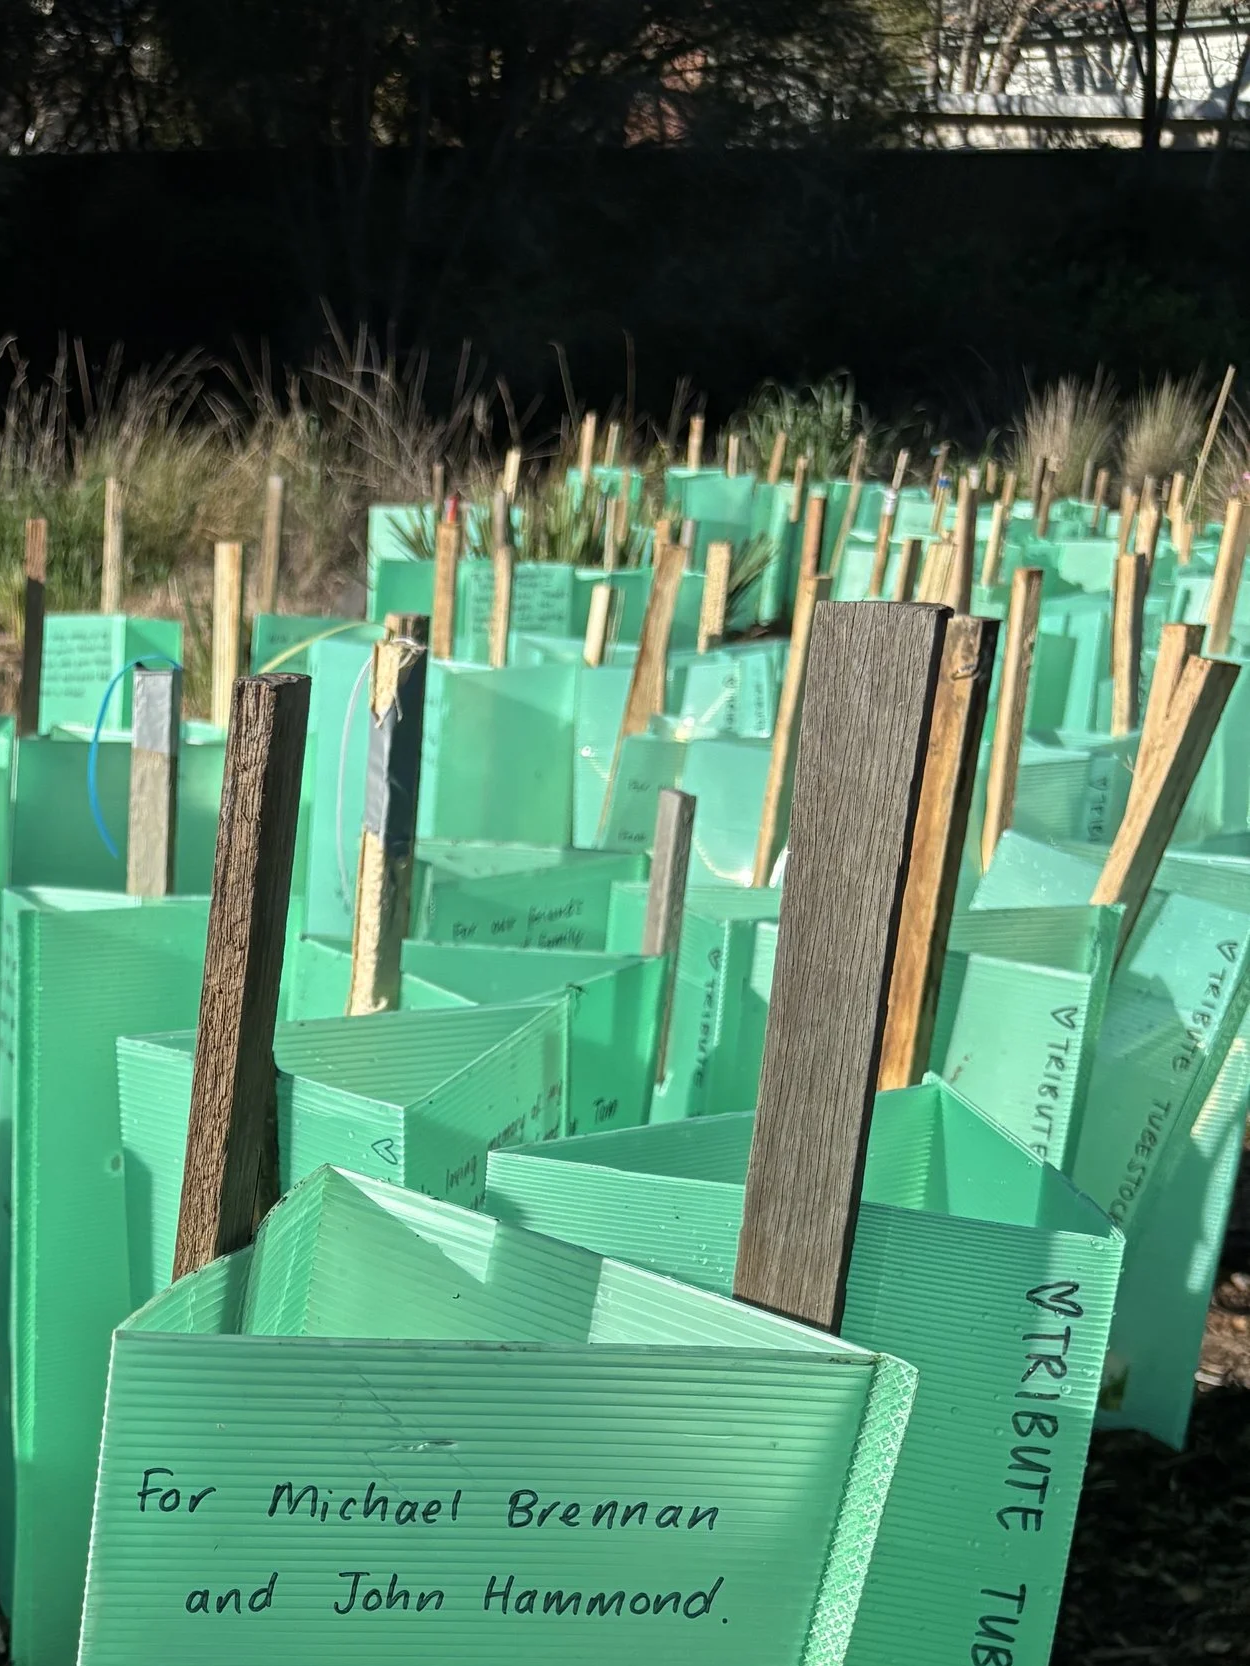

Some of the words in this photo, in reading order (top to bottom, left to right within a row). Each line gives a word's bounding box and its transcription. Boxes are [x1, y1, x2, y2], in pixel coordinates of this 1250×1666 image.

[1159, 966, 1228, 1076] TRIBUTE
[1029, 1037, 1070, 1158] TRIBUTE
[996, 1325, 1071, 1532] TRIBUTE
[137, 1467, 216, 1514] For
[268, 1480, 462, 1526] Michael
[507, 1489, 721, 1532] Brennan
[185, 1571, 278, 1615] and
[333, 1570, 444, 1615] John
[483, 1574, 730, 1625] Hammond.
